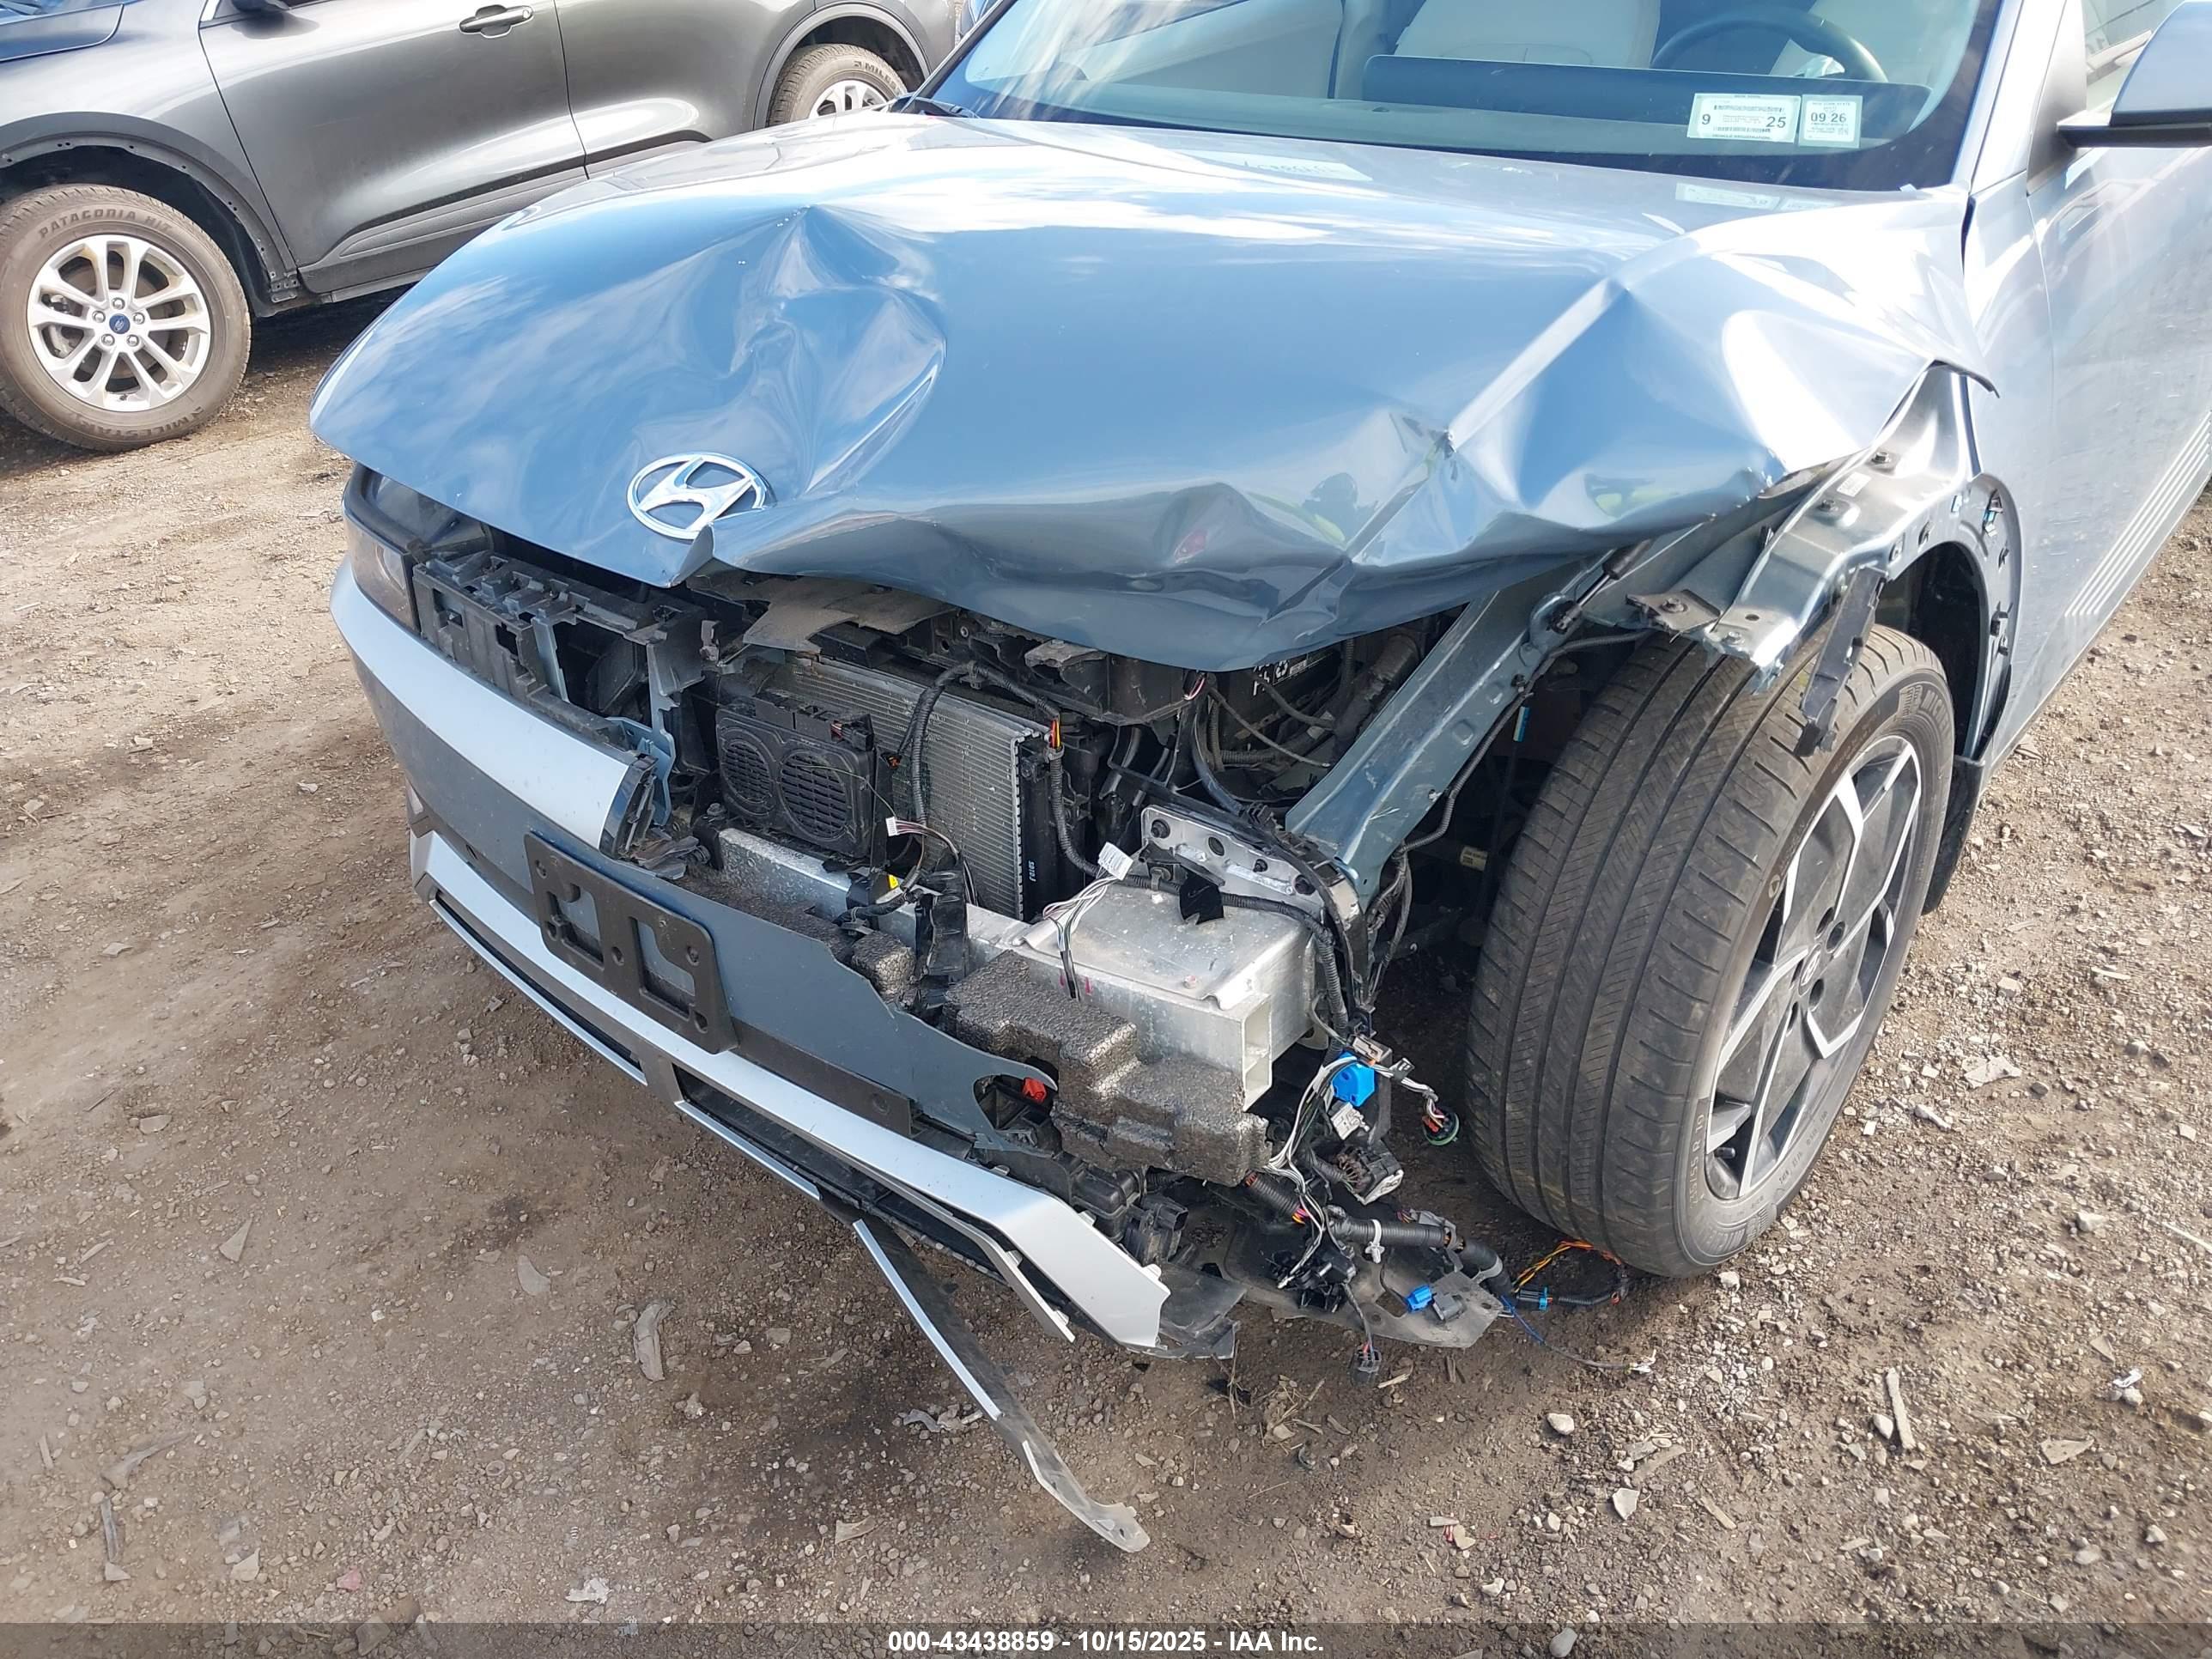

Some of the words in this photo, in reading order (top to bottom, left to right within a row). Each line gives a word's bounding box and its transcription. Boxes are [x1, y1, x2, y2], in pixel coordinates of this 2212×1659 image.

[865, 62, 900, 93] MILES
[1701, 113, 1711, 125] 9
[1765, 116, 1787, 129] 25
[1810, 112, 1826, 123] 09
[1830, 112, 1847, 123] 26
[39, 209, 137, 239] PATAGONIA
[1692, 1140, 1701, 1152] R
